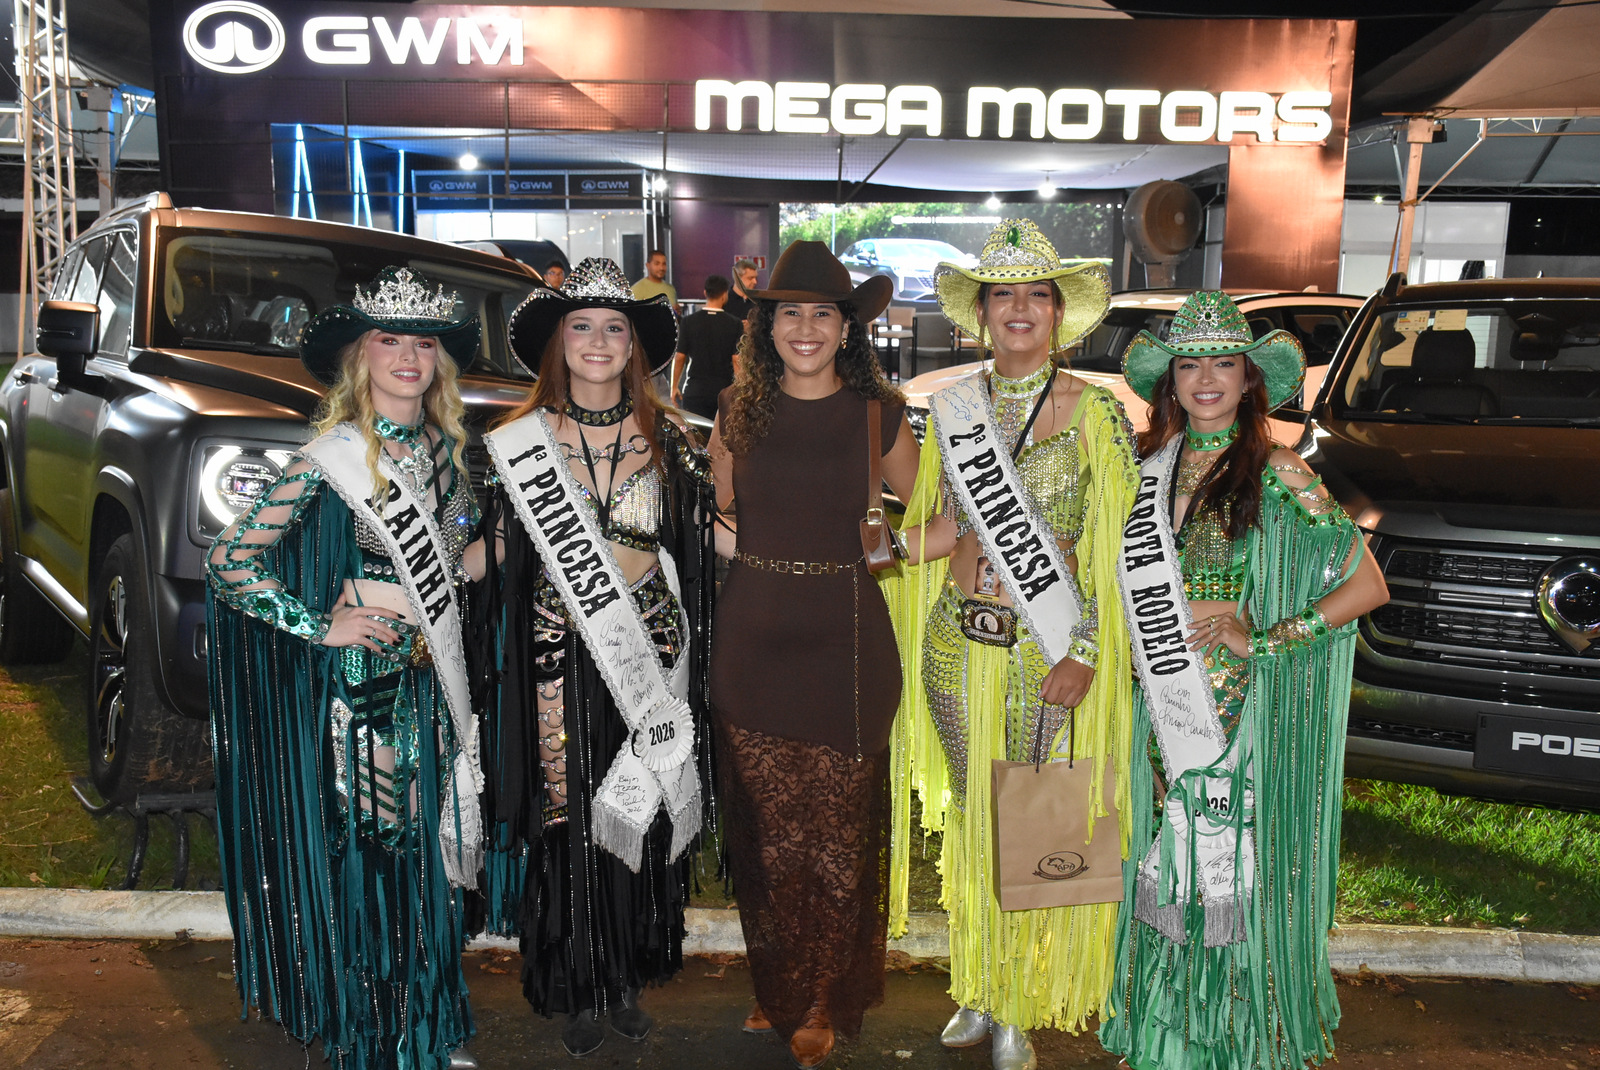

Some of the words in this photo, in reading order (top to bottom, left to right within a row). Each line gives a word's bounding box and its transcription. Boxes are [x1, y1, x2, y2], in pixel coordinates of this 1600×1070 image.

[302, 16, 525, 66] GWM
[695, 79, 943, 136] MEGA
[966, 86, 1333, 142] MOTORS
[445, 182, 477, 190] GWM
[520, 181, 553, 190] GWM
[597, 181, 630, 189] GWM
[519, 466, 621, 619] PRINCESA
[958, 447, 1060, 602] PRINCESA
[1131, 582, 1190, 676] RODEIO
[649, 721, 675, 746] 2026
